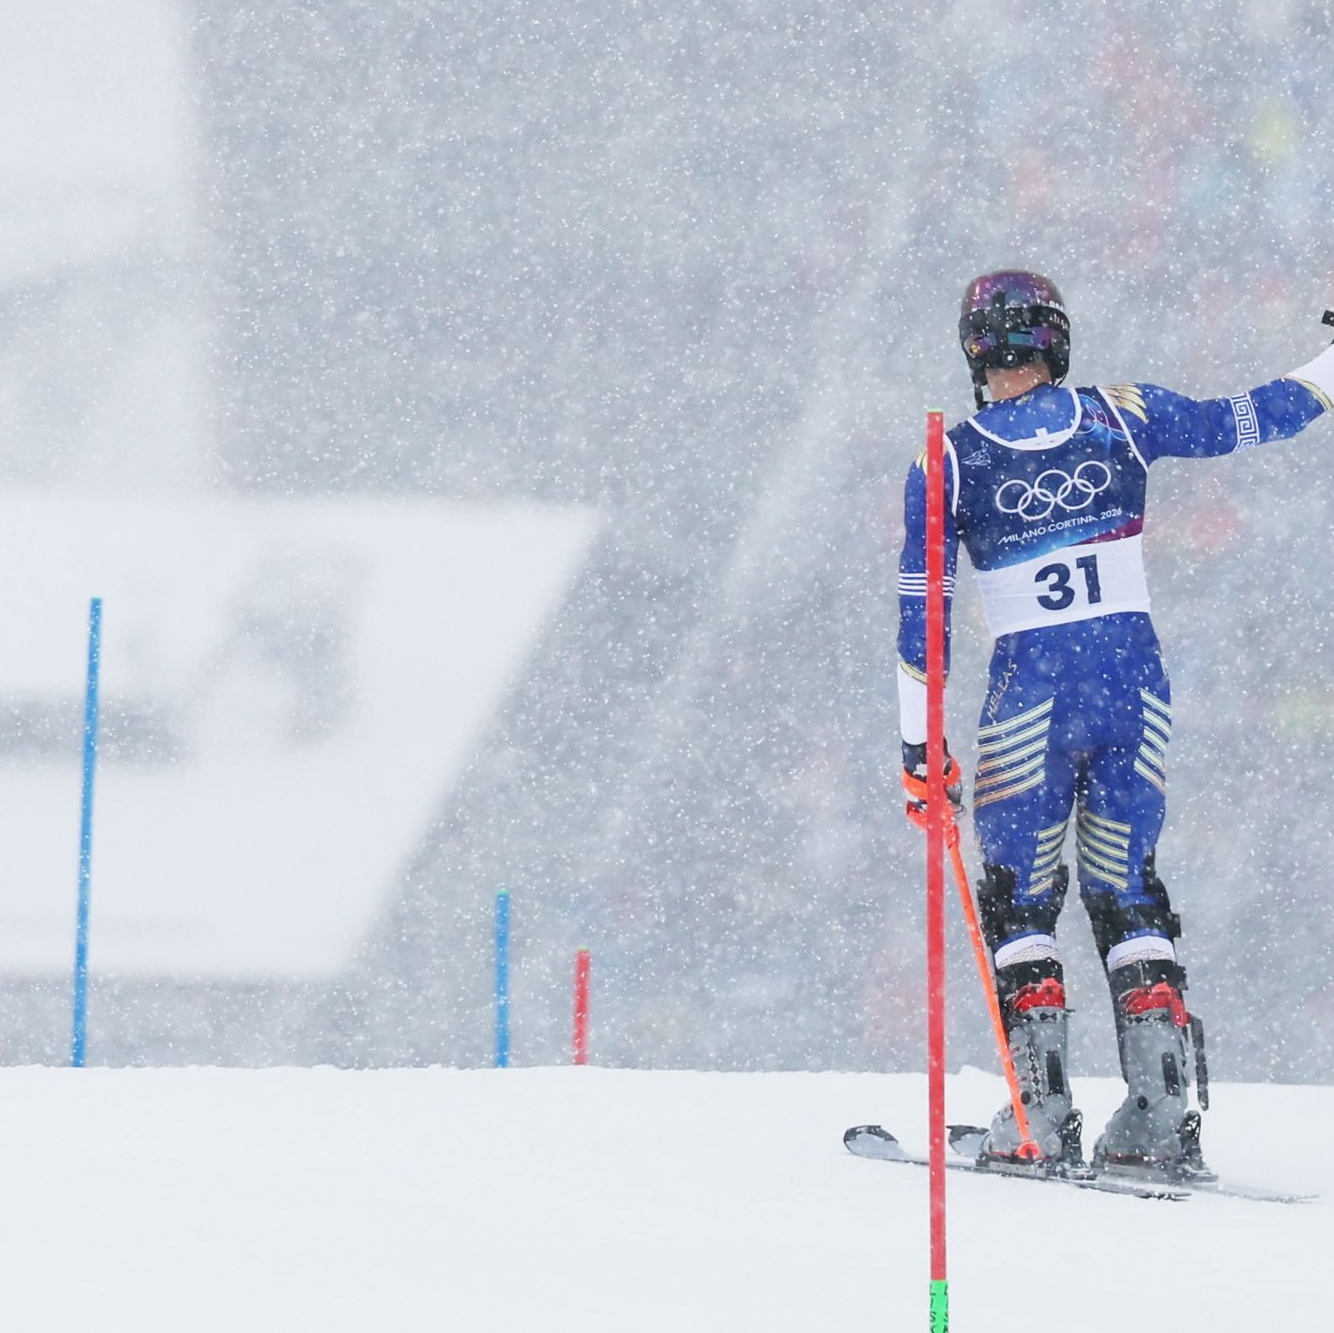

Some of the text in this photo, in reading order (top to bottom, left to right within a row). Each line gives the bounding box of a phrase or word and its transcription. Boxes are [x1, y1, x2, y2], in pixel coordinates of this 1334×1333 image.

[997, 509, 1122, 545] MILANO CORTINA 2026
[1034, 555, 1101, 611] 31
